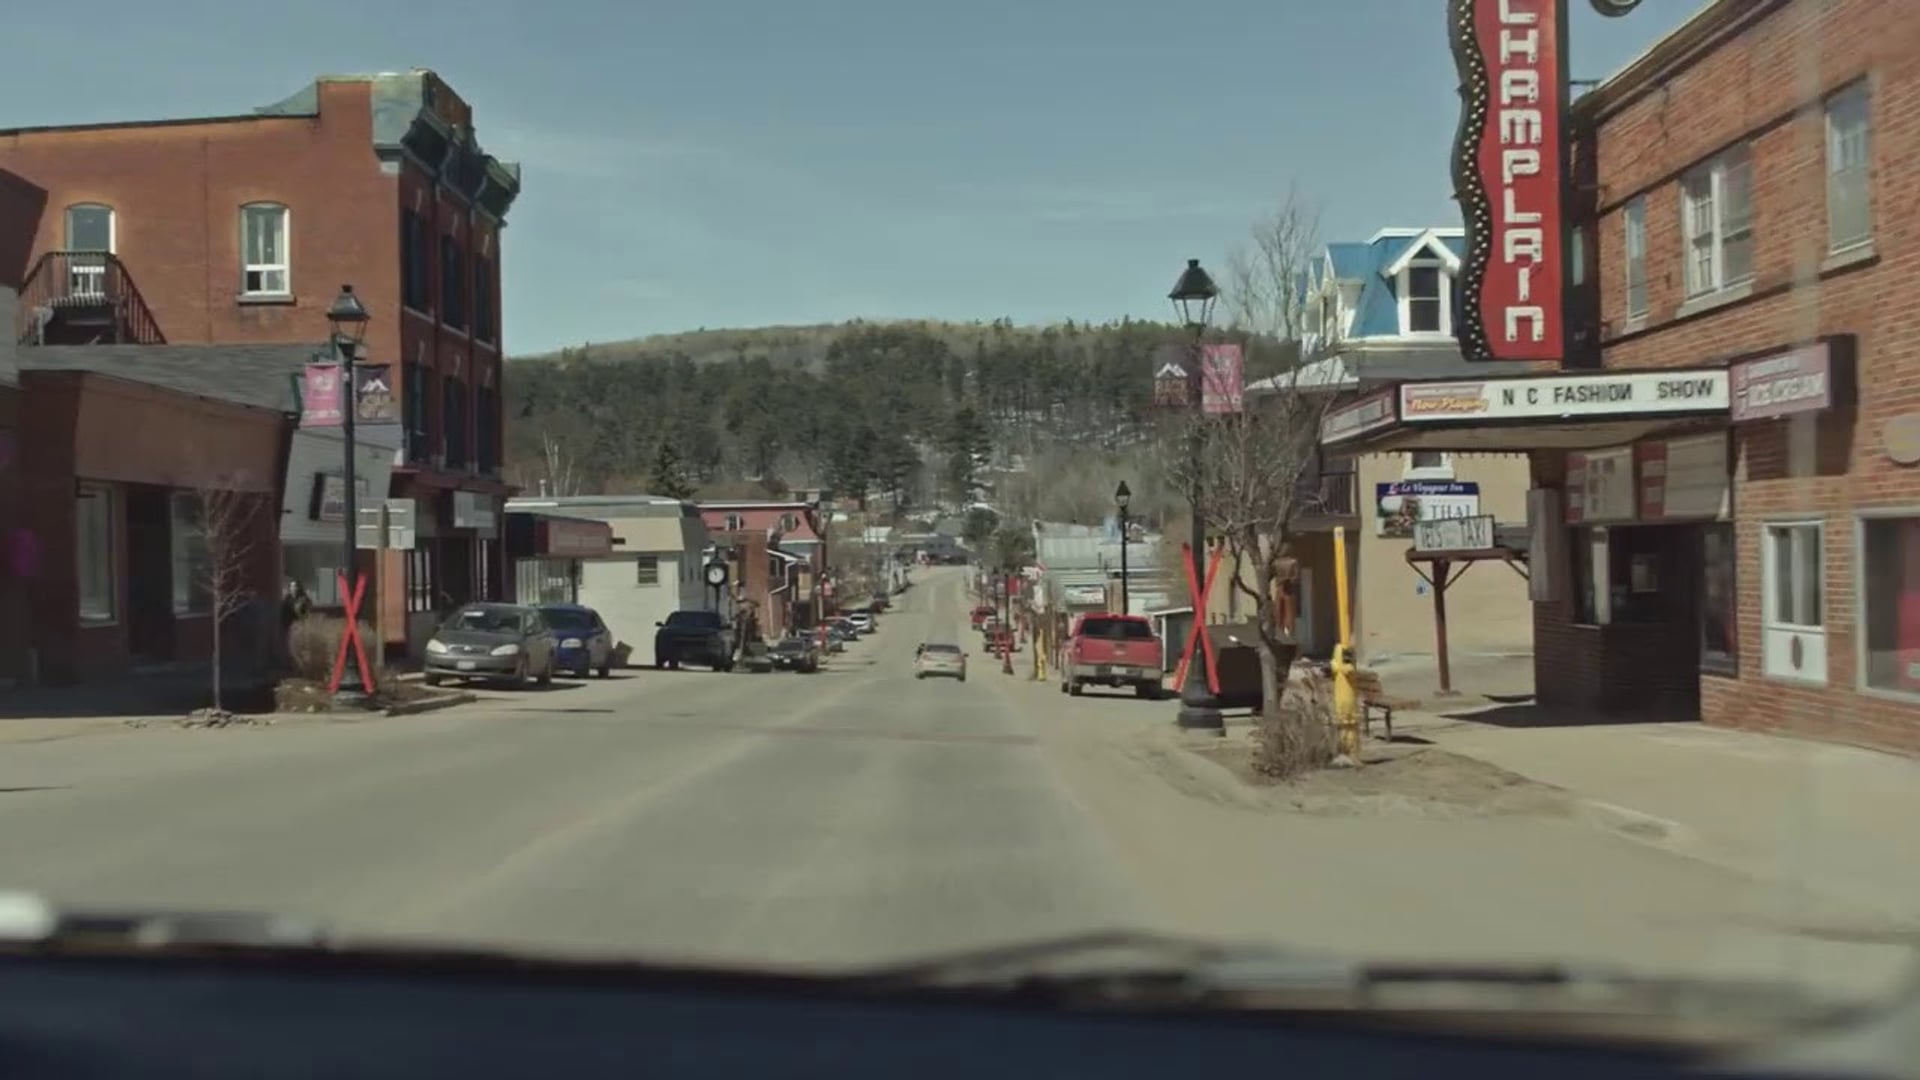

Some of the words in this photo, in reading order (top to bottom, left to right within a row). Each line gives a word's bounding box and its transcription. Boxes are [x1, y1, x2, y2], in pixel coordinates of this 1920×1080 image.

[1498, 0, 1544, 342] CHAMPLAIN
[1502, 390, 1514, 406] N
[1526, 389, 1539, 405] C
[1553, 384, 1632, 405] FASHION
[1656, 379, 1714, 400] SHOW
[1413, 482, 1449, 495] Voyageur
[1449, 483, 1464, 492] Inn
[1430, 503, 1471, 520] THAI
[1460, 518, 1486, 547] TAXI
